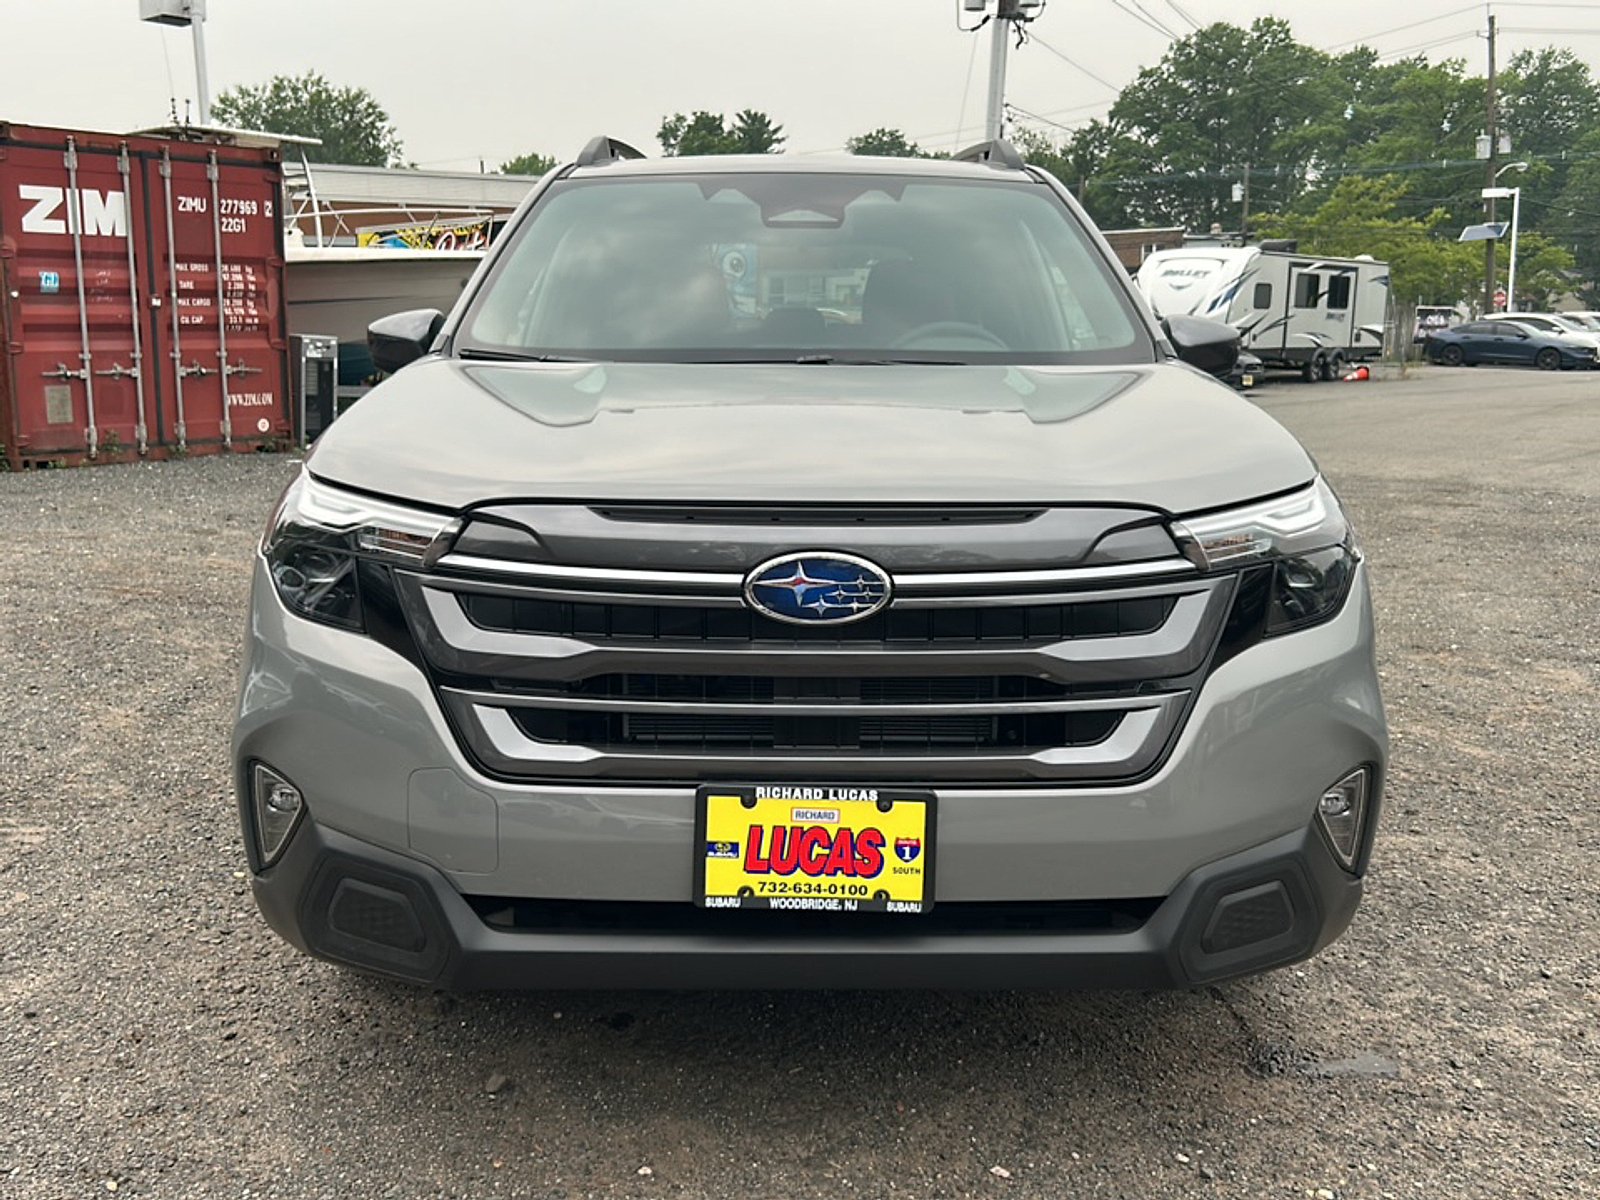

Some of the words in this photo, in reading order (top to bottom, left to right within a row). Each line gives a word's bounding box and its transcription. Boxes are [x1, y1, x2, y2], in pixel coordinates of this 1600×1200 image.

[18, 184, 128, 237] ZIM
[177, 196, 207, 213] ZIMU
[220, 199, 258, 215] 277969
[221, 217, 246, 233] 22G1
[178, 280, 194, 290] TARE
[192, 298, 211, 307] CARGO
[755, 787, 823, 800] RICHARD
[828, 788, 878, 801] LUCAS
[795, 810, 835, 820] RICHARD
[743, 824, 886, 879] LUCAS
[902, 846, 912, 860] 1
[893, 867, 921, 875] SOUTH
[757, 881, 868, 896] 732-634-0100
[704, 896, 742, 908] SUBARU
[843, 899, 858, 911] NJ
[886, 901, 922, 913] SUBARU
